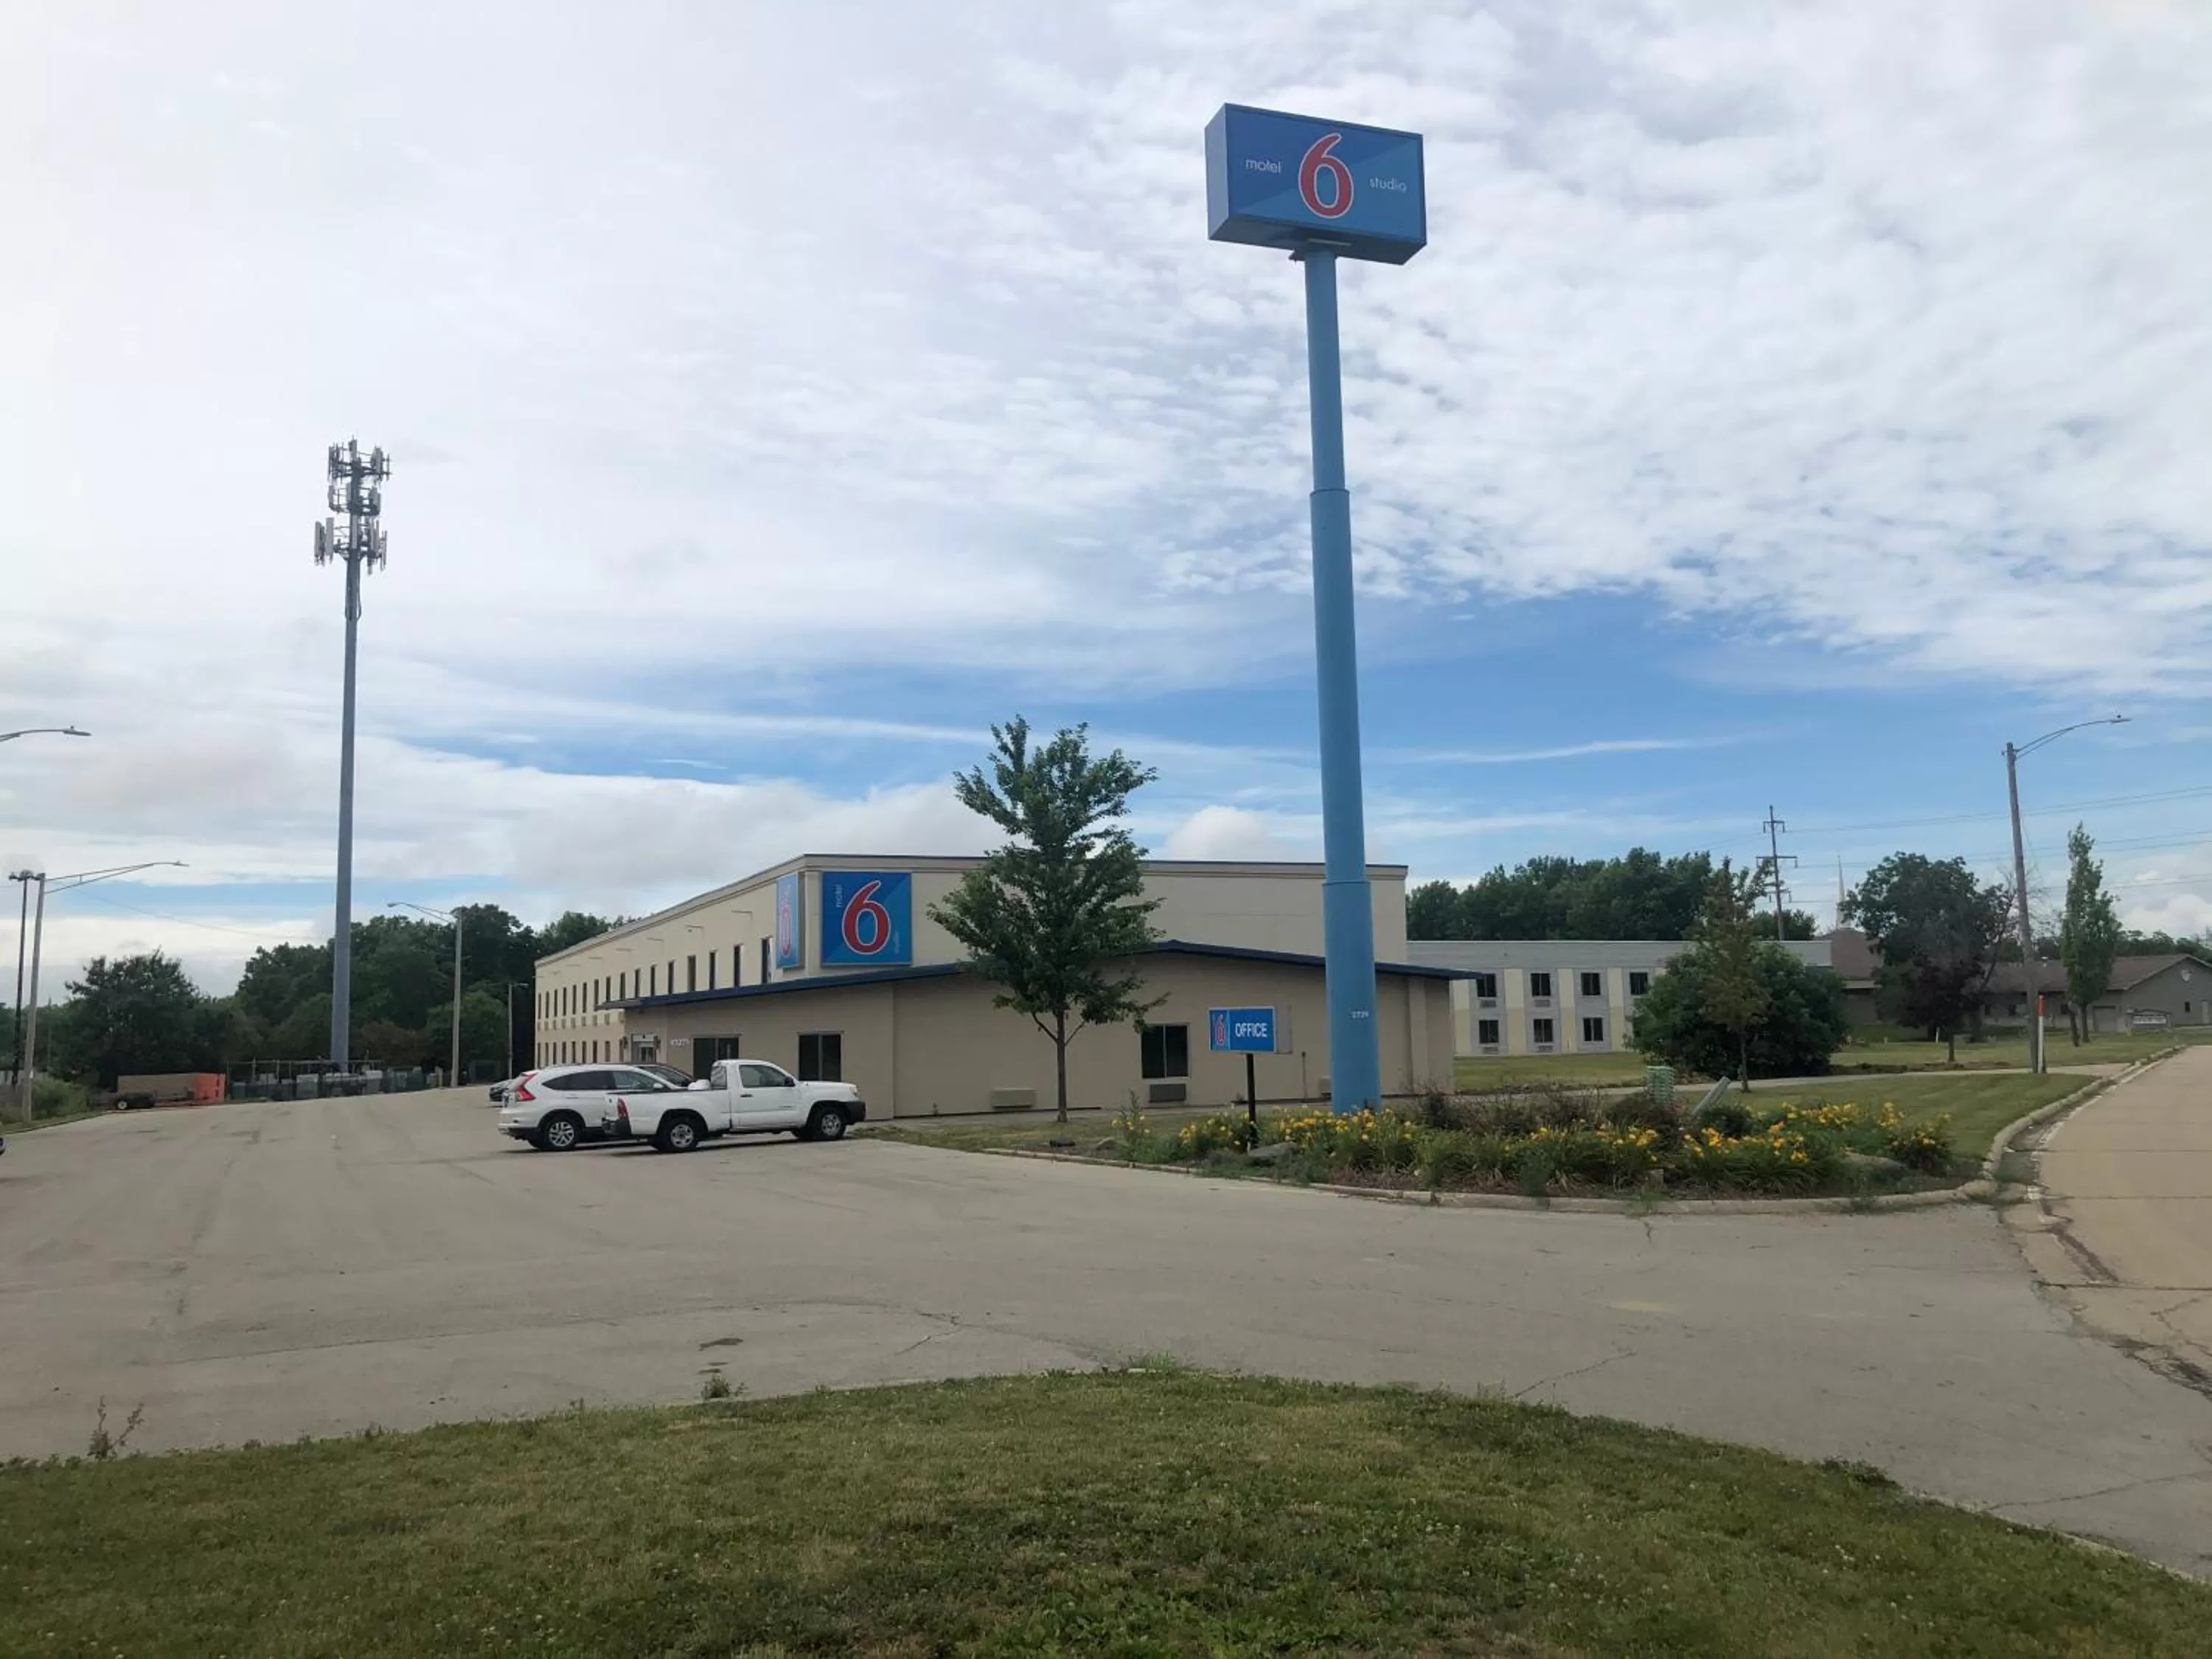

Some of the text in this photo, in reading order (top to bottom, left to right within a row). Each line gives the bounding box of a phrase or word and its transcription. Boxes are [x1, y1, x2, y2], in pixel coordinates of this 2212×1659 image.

[1245, 132, 1406, 219] motel 6 studio
[842, 880, 891, 955] 6
[1235, 1022, 1267, 1038] OFFICE
